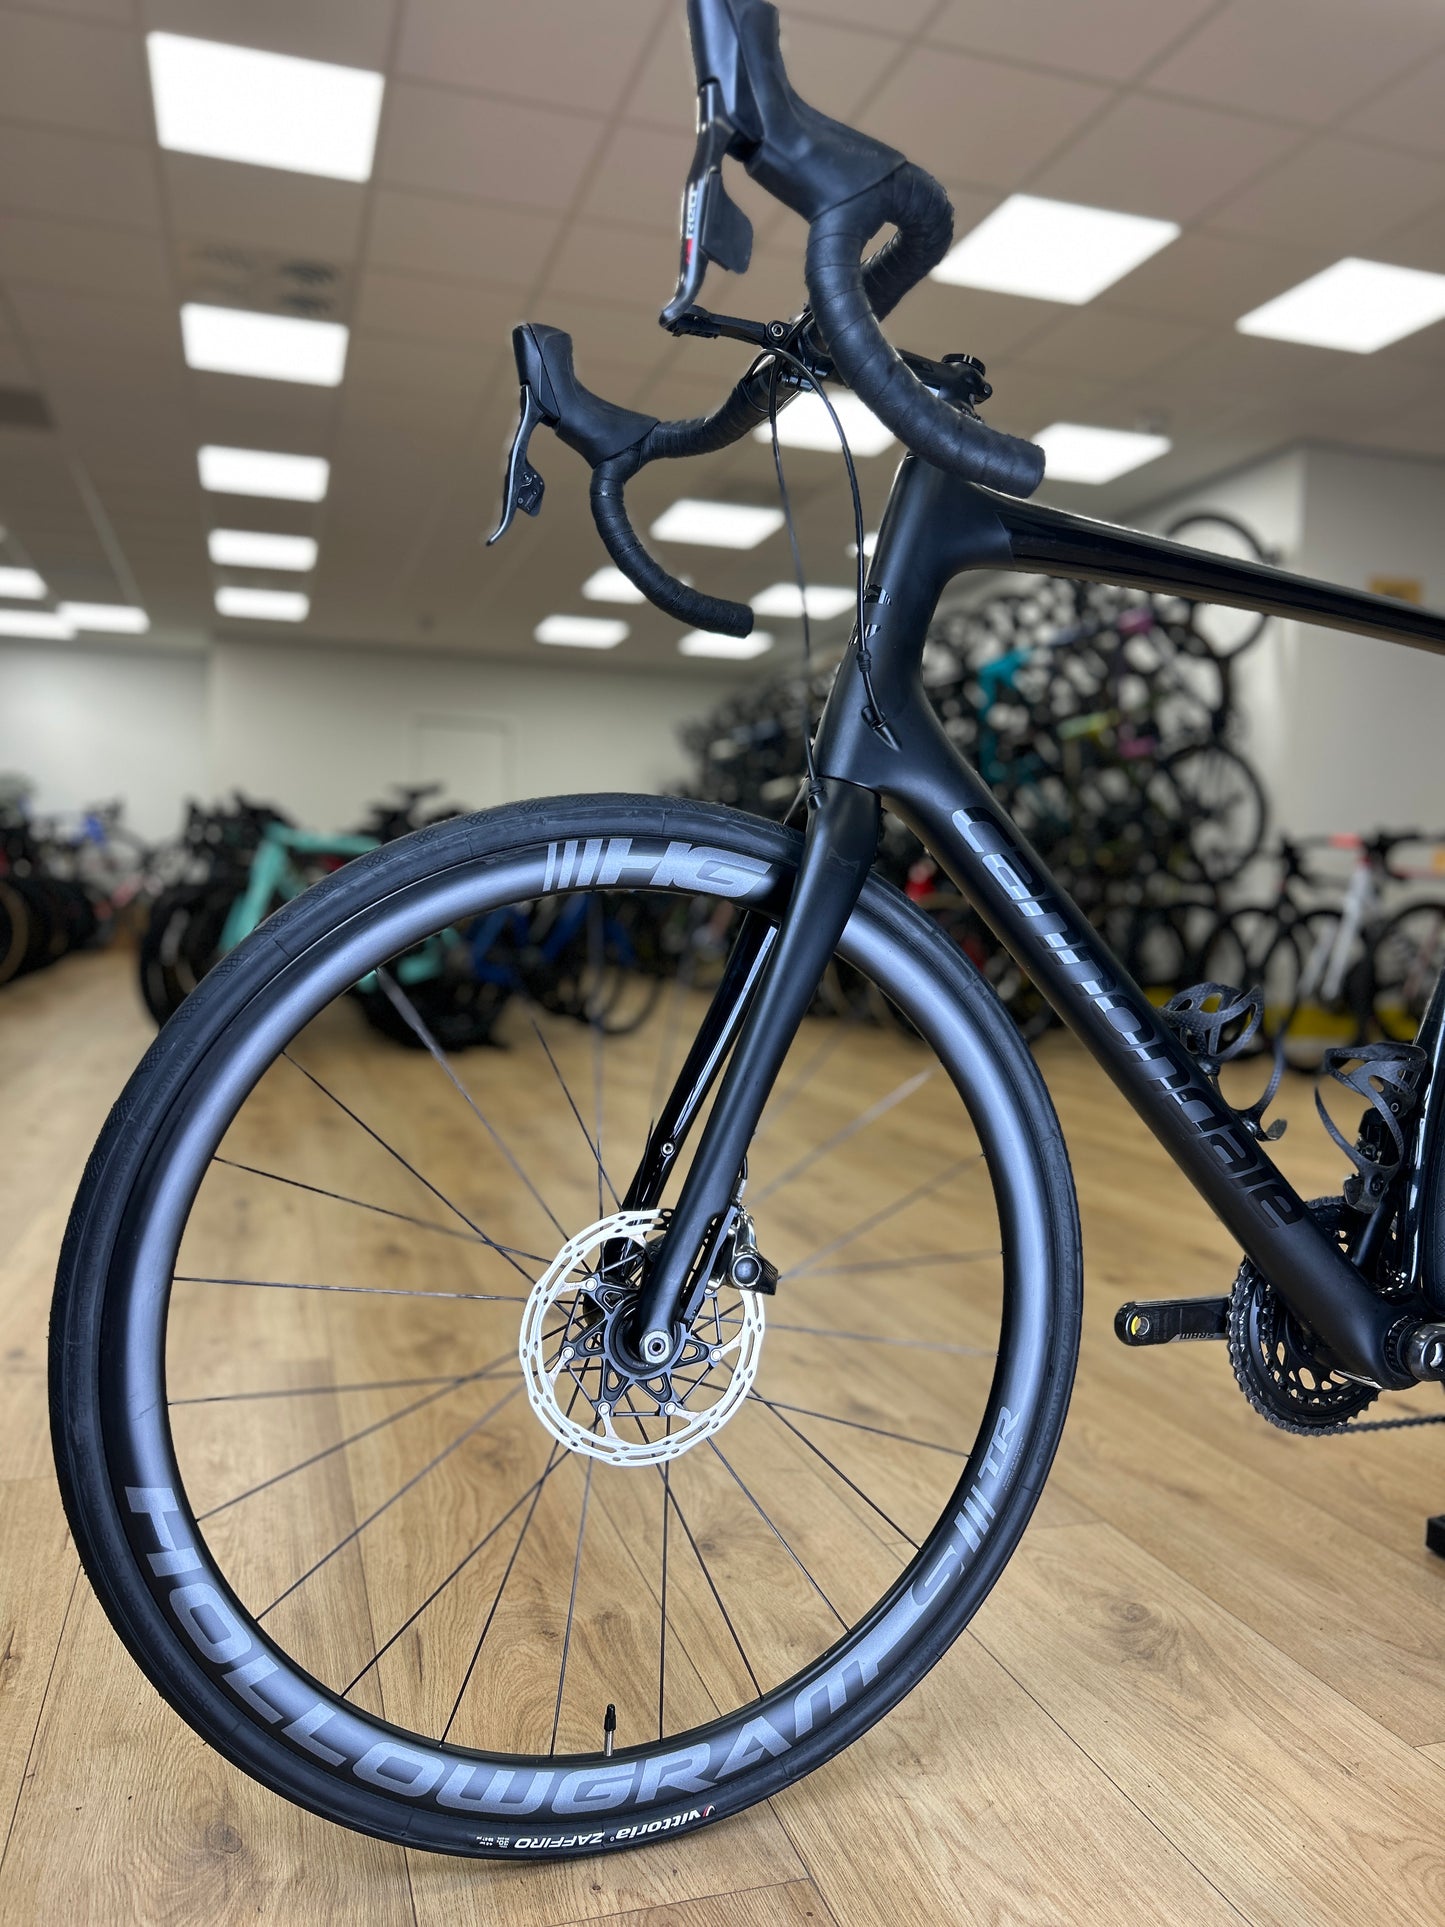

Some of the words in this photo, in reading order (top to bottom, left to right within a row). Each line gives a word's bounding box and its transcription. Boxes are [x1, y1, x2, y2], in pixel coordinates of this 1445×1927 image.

[951, 807, 1304, 1228] cannondale
[977, 1406, 1021, 1480] TR
[514, 1832, 606, 1849] ZAFFIRO
